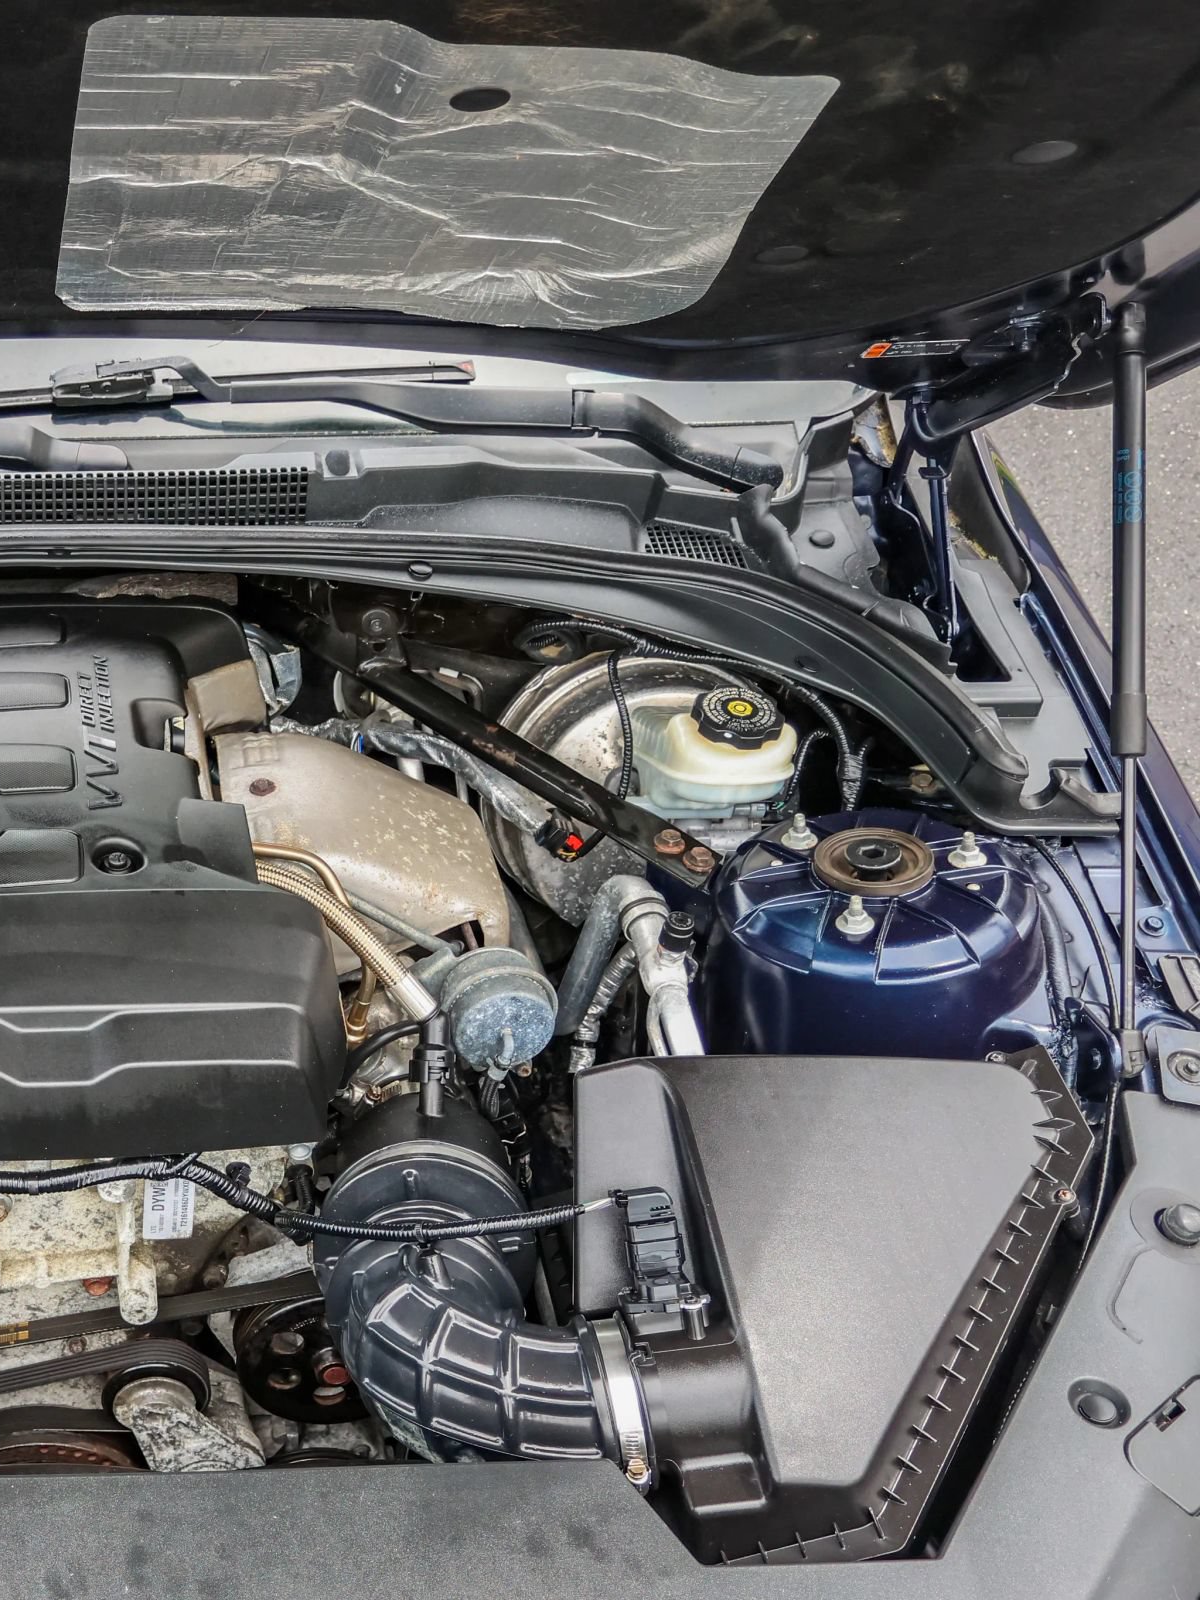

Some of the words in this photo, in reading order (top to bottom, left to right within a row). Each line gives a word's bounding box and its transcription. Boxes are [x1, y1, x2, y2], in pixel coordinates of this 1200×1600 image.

[76, 671, 96, 728] DIRECT
[92, 654, 115, 734] INJECTION
[82, 725, 123, 811] VVT
[151, 1186, 166, 1211] DYW
